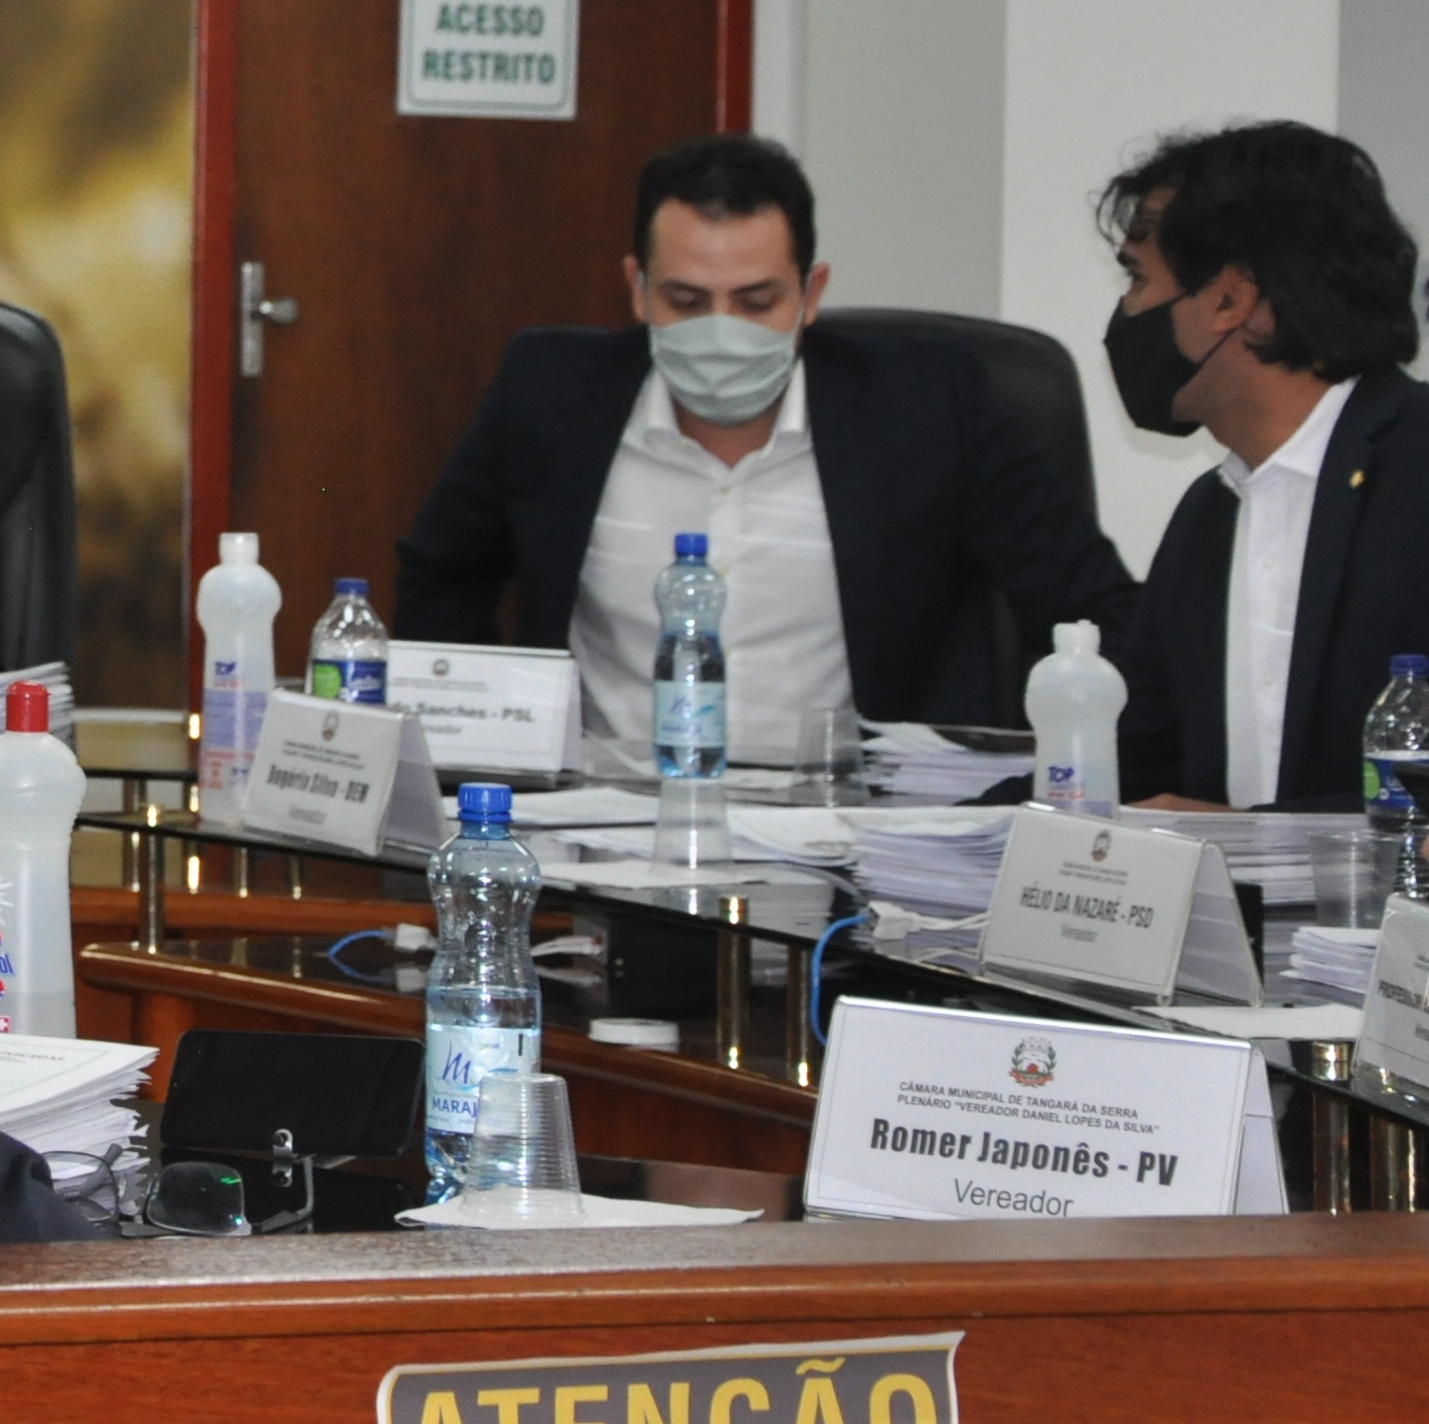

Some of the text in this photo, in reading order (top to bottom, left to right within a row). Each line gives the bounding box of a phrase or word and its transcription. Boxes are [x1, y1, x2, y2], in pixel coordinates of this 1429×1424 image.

[436, 3, 545, 38] ACESSO
[422, 49, 556, 85] RESTRITO
[1020, 881, 1052, 910] HÉLIO
[1053, 892, 1070, 914] DA
[1073, 895, 1122, 923] NAZARÉ
[1127, 904, 1154, 929] PSD
[898, 1094, 952, 1110] PLENÁRIO
[1022, 1109, 1062, 1124] DANIEL
[1065, 1114, 1102, 1128] LOPES
[1105, 1119, 1120, 1131] DA
[900, 1081, 1139, 1120] CÂMARA MUNICIPAL DE TANGARÁ DA SERRA
[870, 1118, 972, 1162] Romer
[977, 1130, 1111, 1179] Japonês
[1136, 1150, 1178, 1187] PV
[954, 1178, 1075, 1217] Vereador
